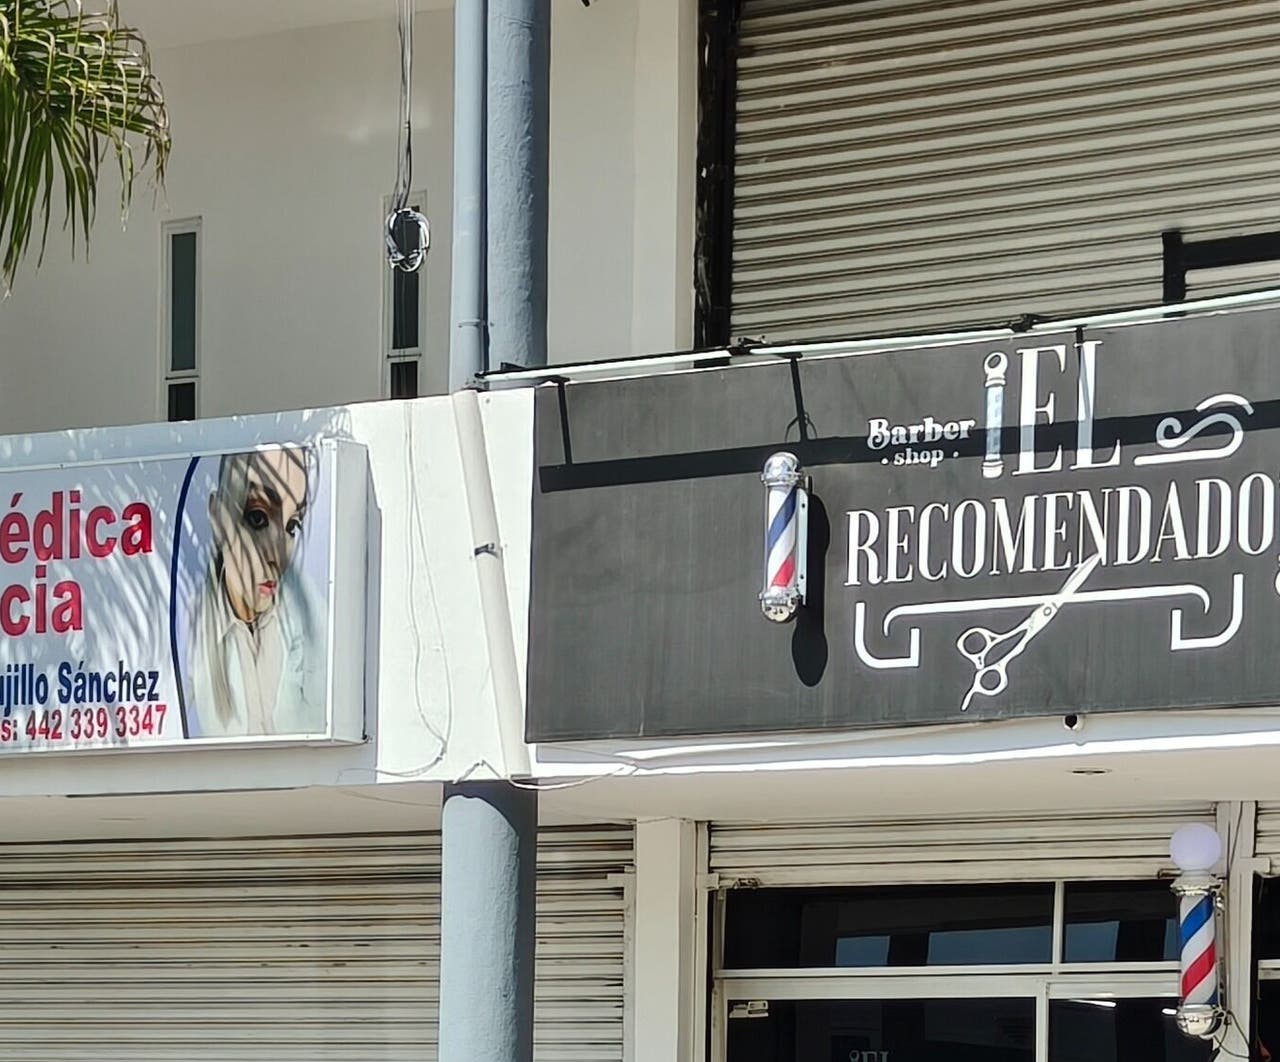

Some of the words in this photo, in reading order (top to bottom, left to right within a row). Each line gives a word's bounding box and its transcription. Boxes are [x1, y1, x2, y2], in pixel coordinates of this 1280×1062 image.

[867, 417, 976, 449] Barber
[894, 448, 944, 468] shop
[844, 473, 1275, 588] RECOMENDADO
[58, 661, 160, 704] Sánchez
[25, 710, 63, 740] 442
[70, 707, 108, 739] 339
[115, 704, 167, 738] 3347
